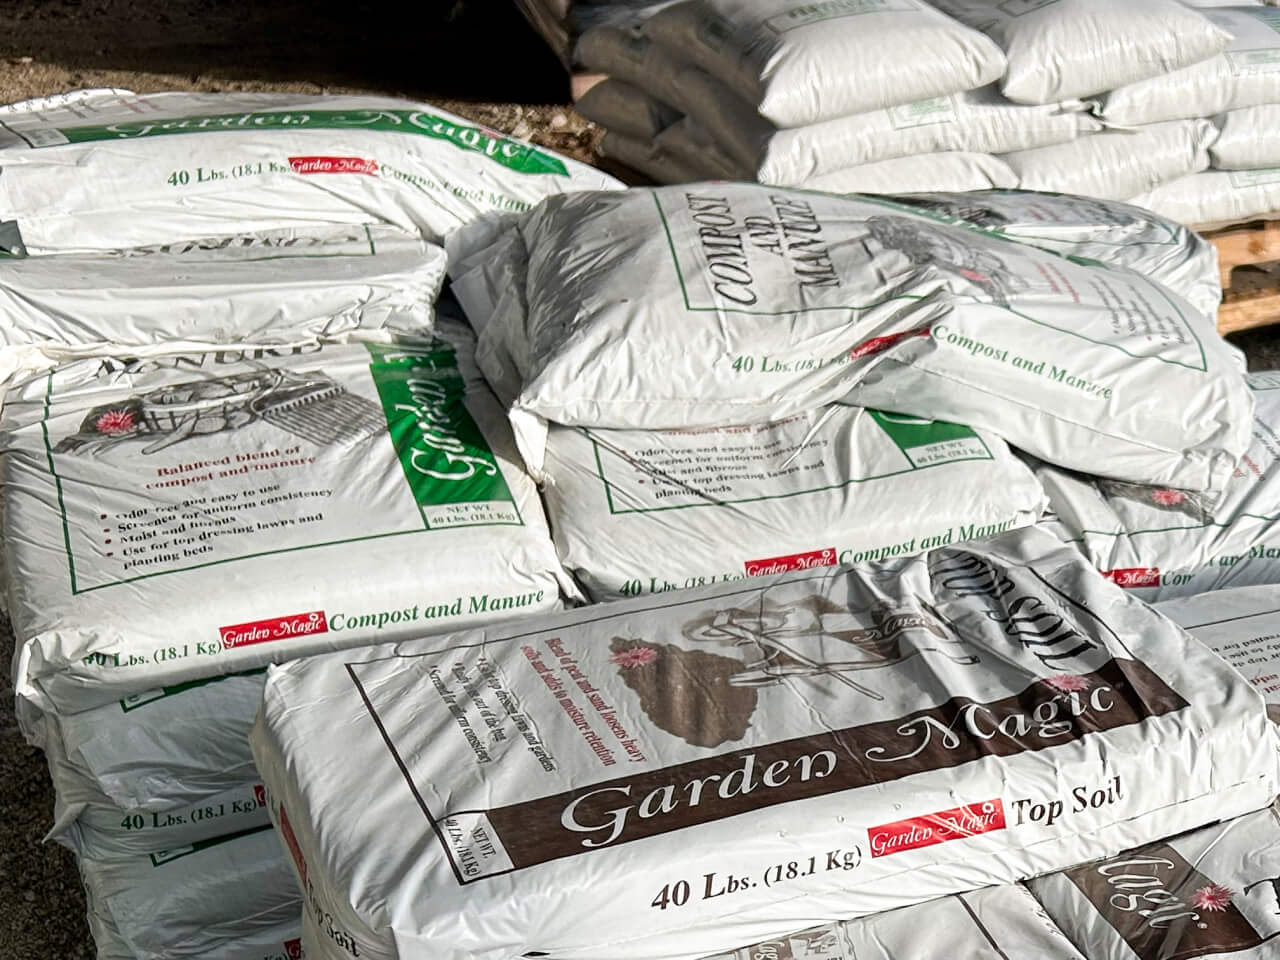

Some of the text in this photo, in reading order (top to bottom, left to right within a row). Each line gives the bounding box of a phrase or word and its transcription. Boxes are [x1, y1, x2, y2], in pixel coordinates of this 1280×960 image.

[168, 171, 189, 186] 40
[197, 168, 228, 183] Lbs.
[685, 193, 757, 306] COMPOST
[744, 215, 784, 256] AND
[731, 356, 792, 373] 40 Lbs.
[933, 325, 1009, 362] Compost
[1013, 355, 1045, 376] and
[145, 456, 317, 491] compost and manure
[156, 446, 300, 477] Balanced blend of
[839, 528, 952, 565] Compost and
[329, 590, 545, 632] Compost and Manure
[561, 685, 1114, 848] Garden Magic
[121, 797, 257, 830] 40 Lbs. (18.1 Kg)
[1011, 776, 1124, 827] Top Soil
[871, 806, 998, 856] Garden Magic
[652, 845, 863, 910] 40 Lbs. (18.1 Kg)
